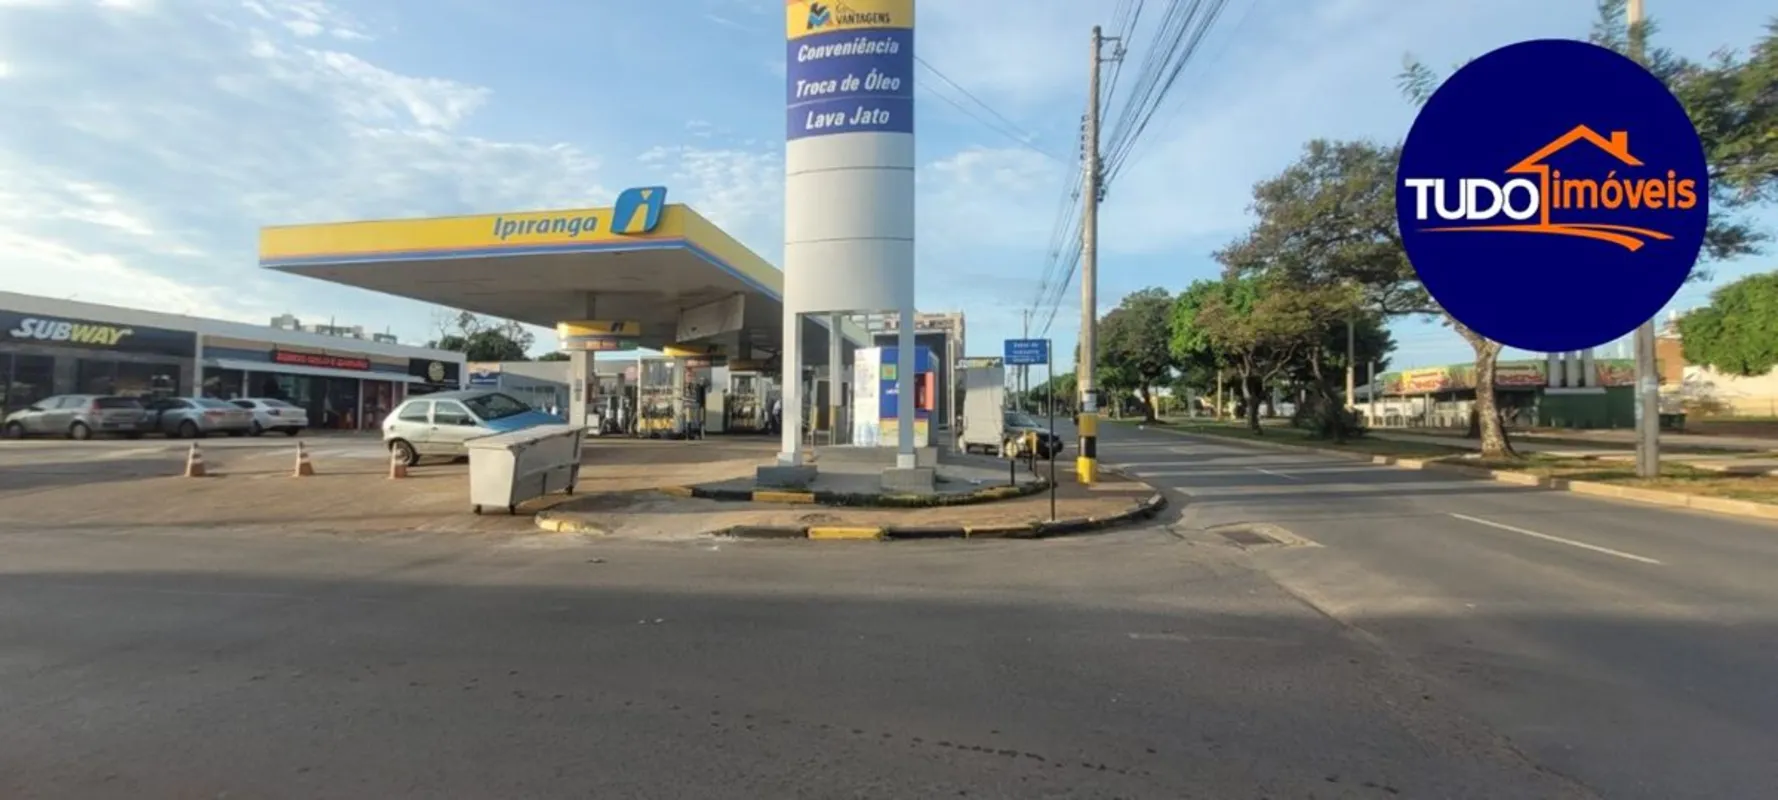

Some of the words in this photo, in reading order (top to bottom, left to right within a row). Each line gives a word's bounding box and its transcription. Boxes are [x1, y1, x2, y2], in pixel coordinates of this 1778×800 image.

[798, 37, 899, 62] Conveniência
[796, 79, 837, 98] Troca
[840, 74, 860, 91] de
[865, 68, 901, 91] Óleo
[806, 110, 845, 130] Lava
[849, 106, 890, 125] Jato
[494, 216, 598, 240] Ipiranga
[9, 318, 134, 345] SUBWAY
